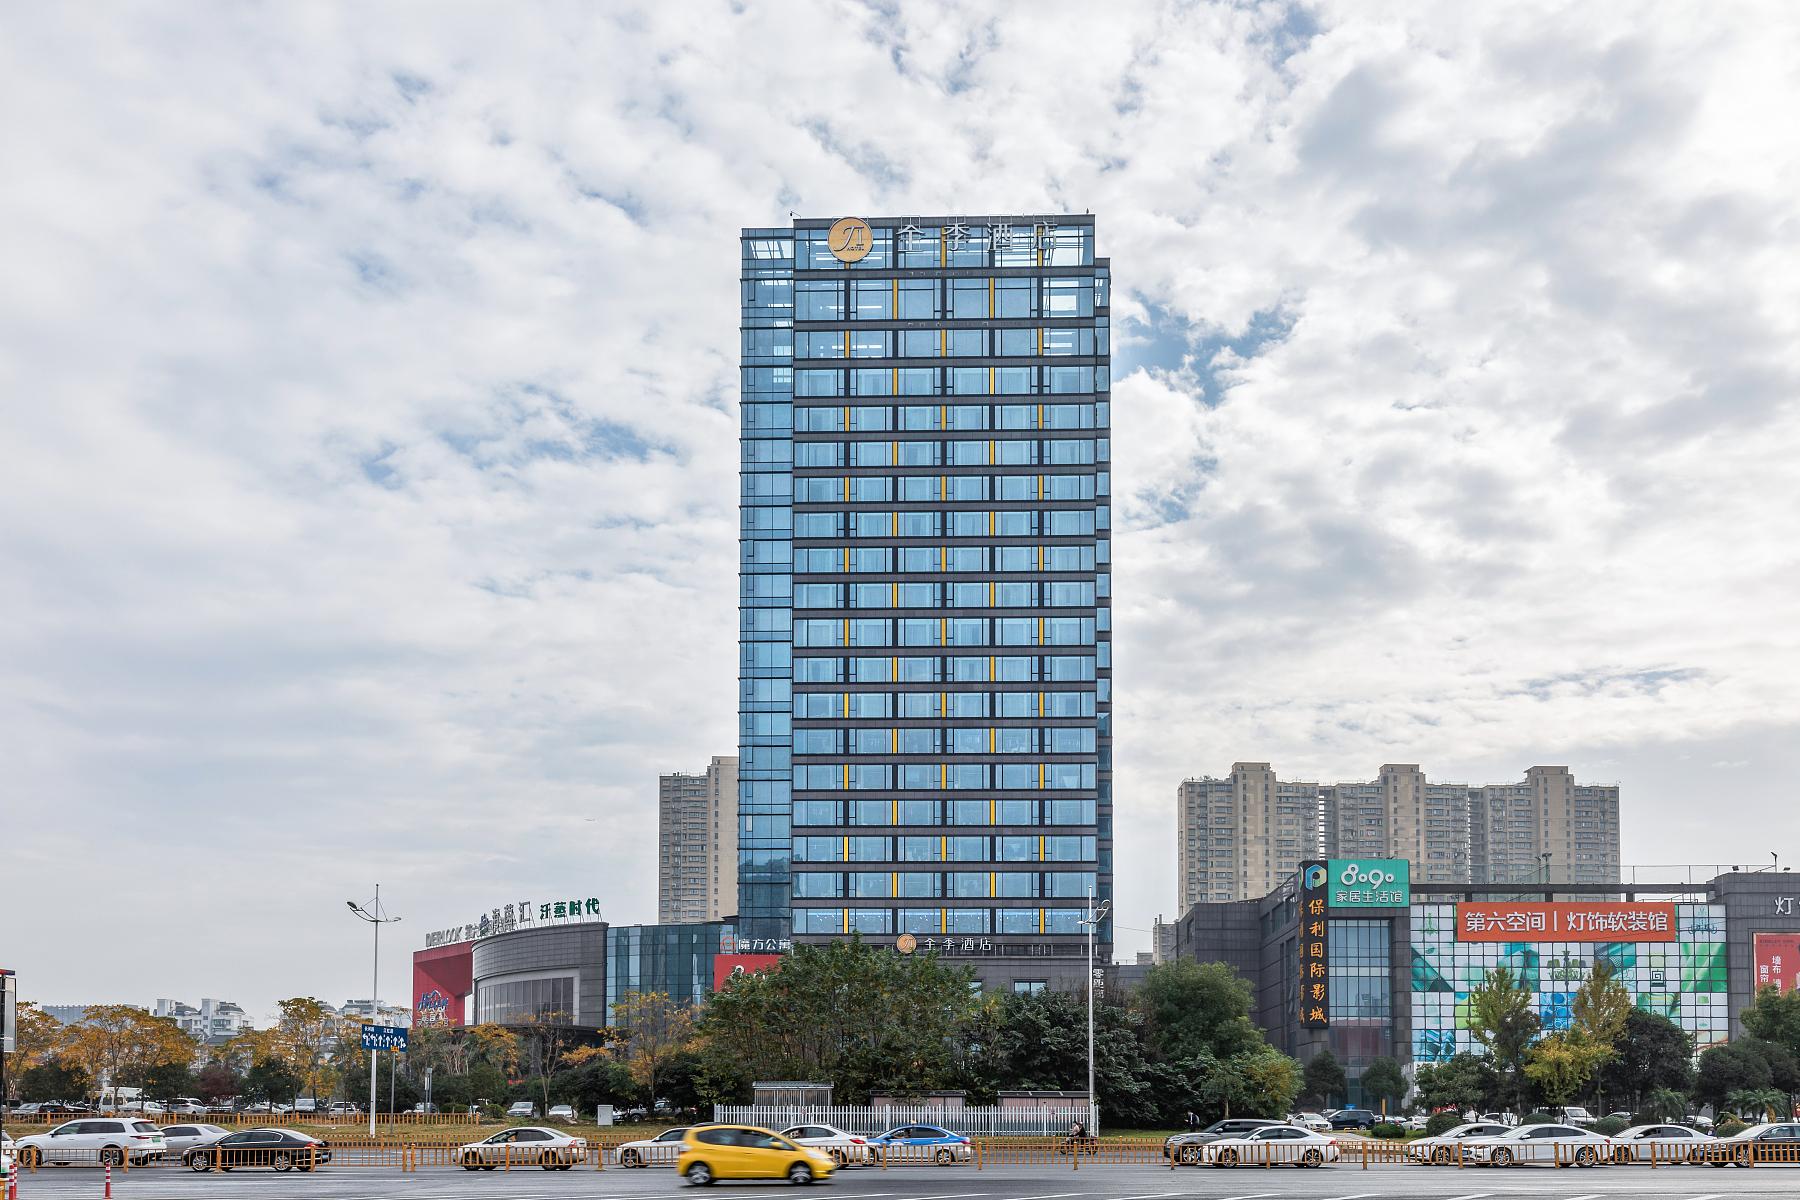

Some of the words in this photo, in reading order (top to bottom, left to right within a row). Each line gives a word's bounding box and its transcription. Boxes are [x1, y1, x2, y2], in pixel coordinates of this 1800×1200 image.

[896, 221, 1058, 252] 全季酒店
[1336, 890, 1403, 903] 家居生活馆
[1775, 896, 1800, 915] 灯
[1464, 911, 1545, 932] 第六空间
[1567, 911, 1668, 932] 灯饰软装馆
[738, 938, 791, 950] 魔方公寓
[924, 937, 991, 951] 全季酒店
[1308, 899, 1328, 1024] 保利国际影城
